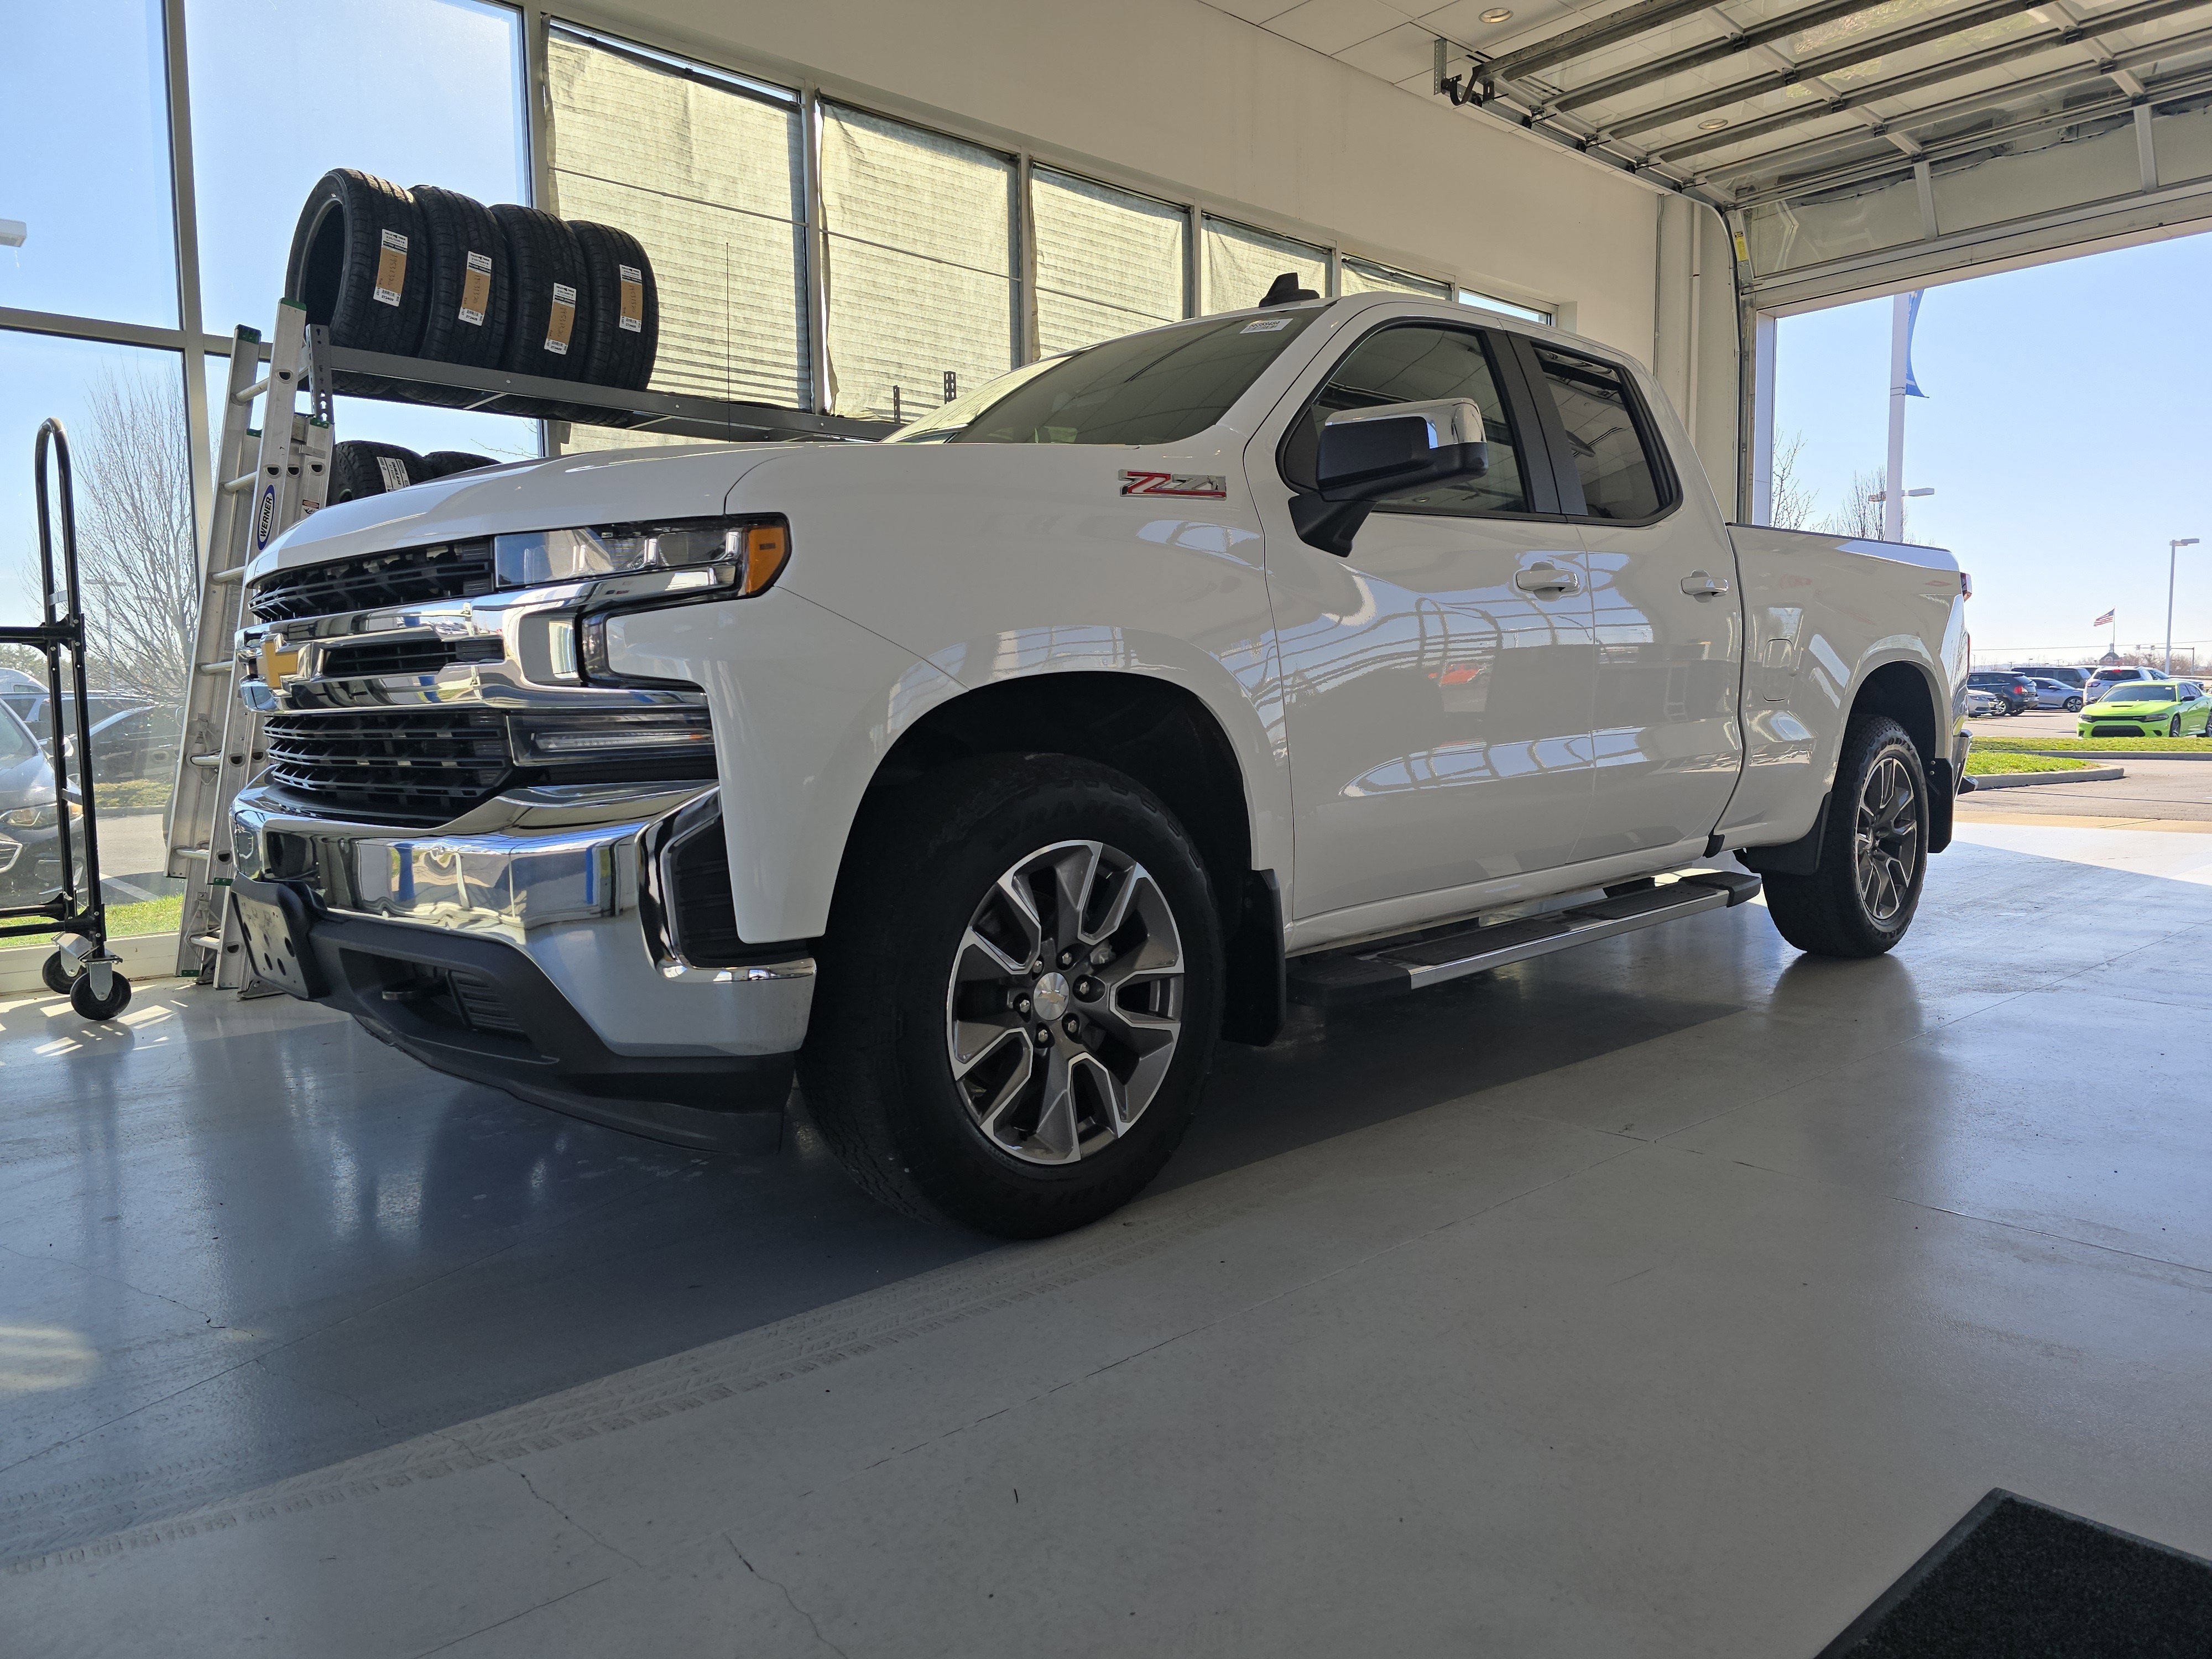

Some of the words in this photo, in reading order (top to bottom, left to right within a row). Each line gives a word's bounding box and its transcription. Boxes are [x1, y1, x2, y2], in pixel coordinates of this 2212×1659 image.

[392, 462, 401, 485] DUELER
[1118, 469, 1227, 500] Z71
[260, 497, 272, 537] WERNER
